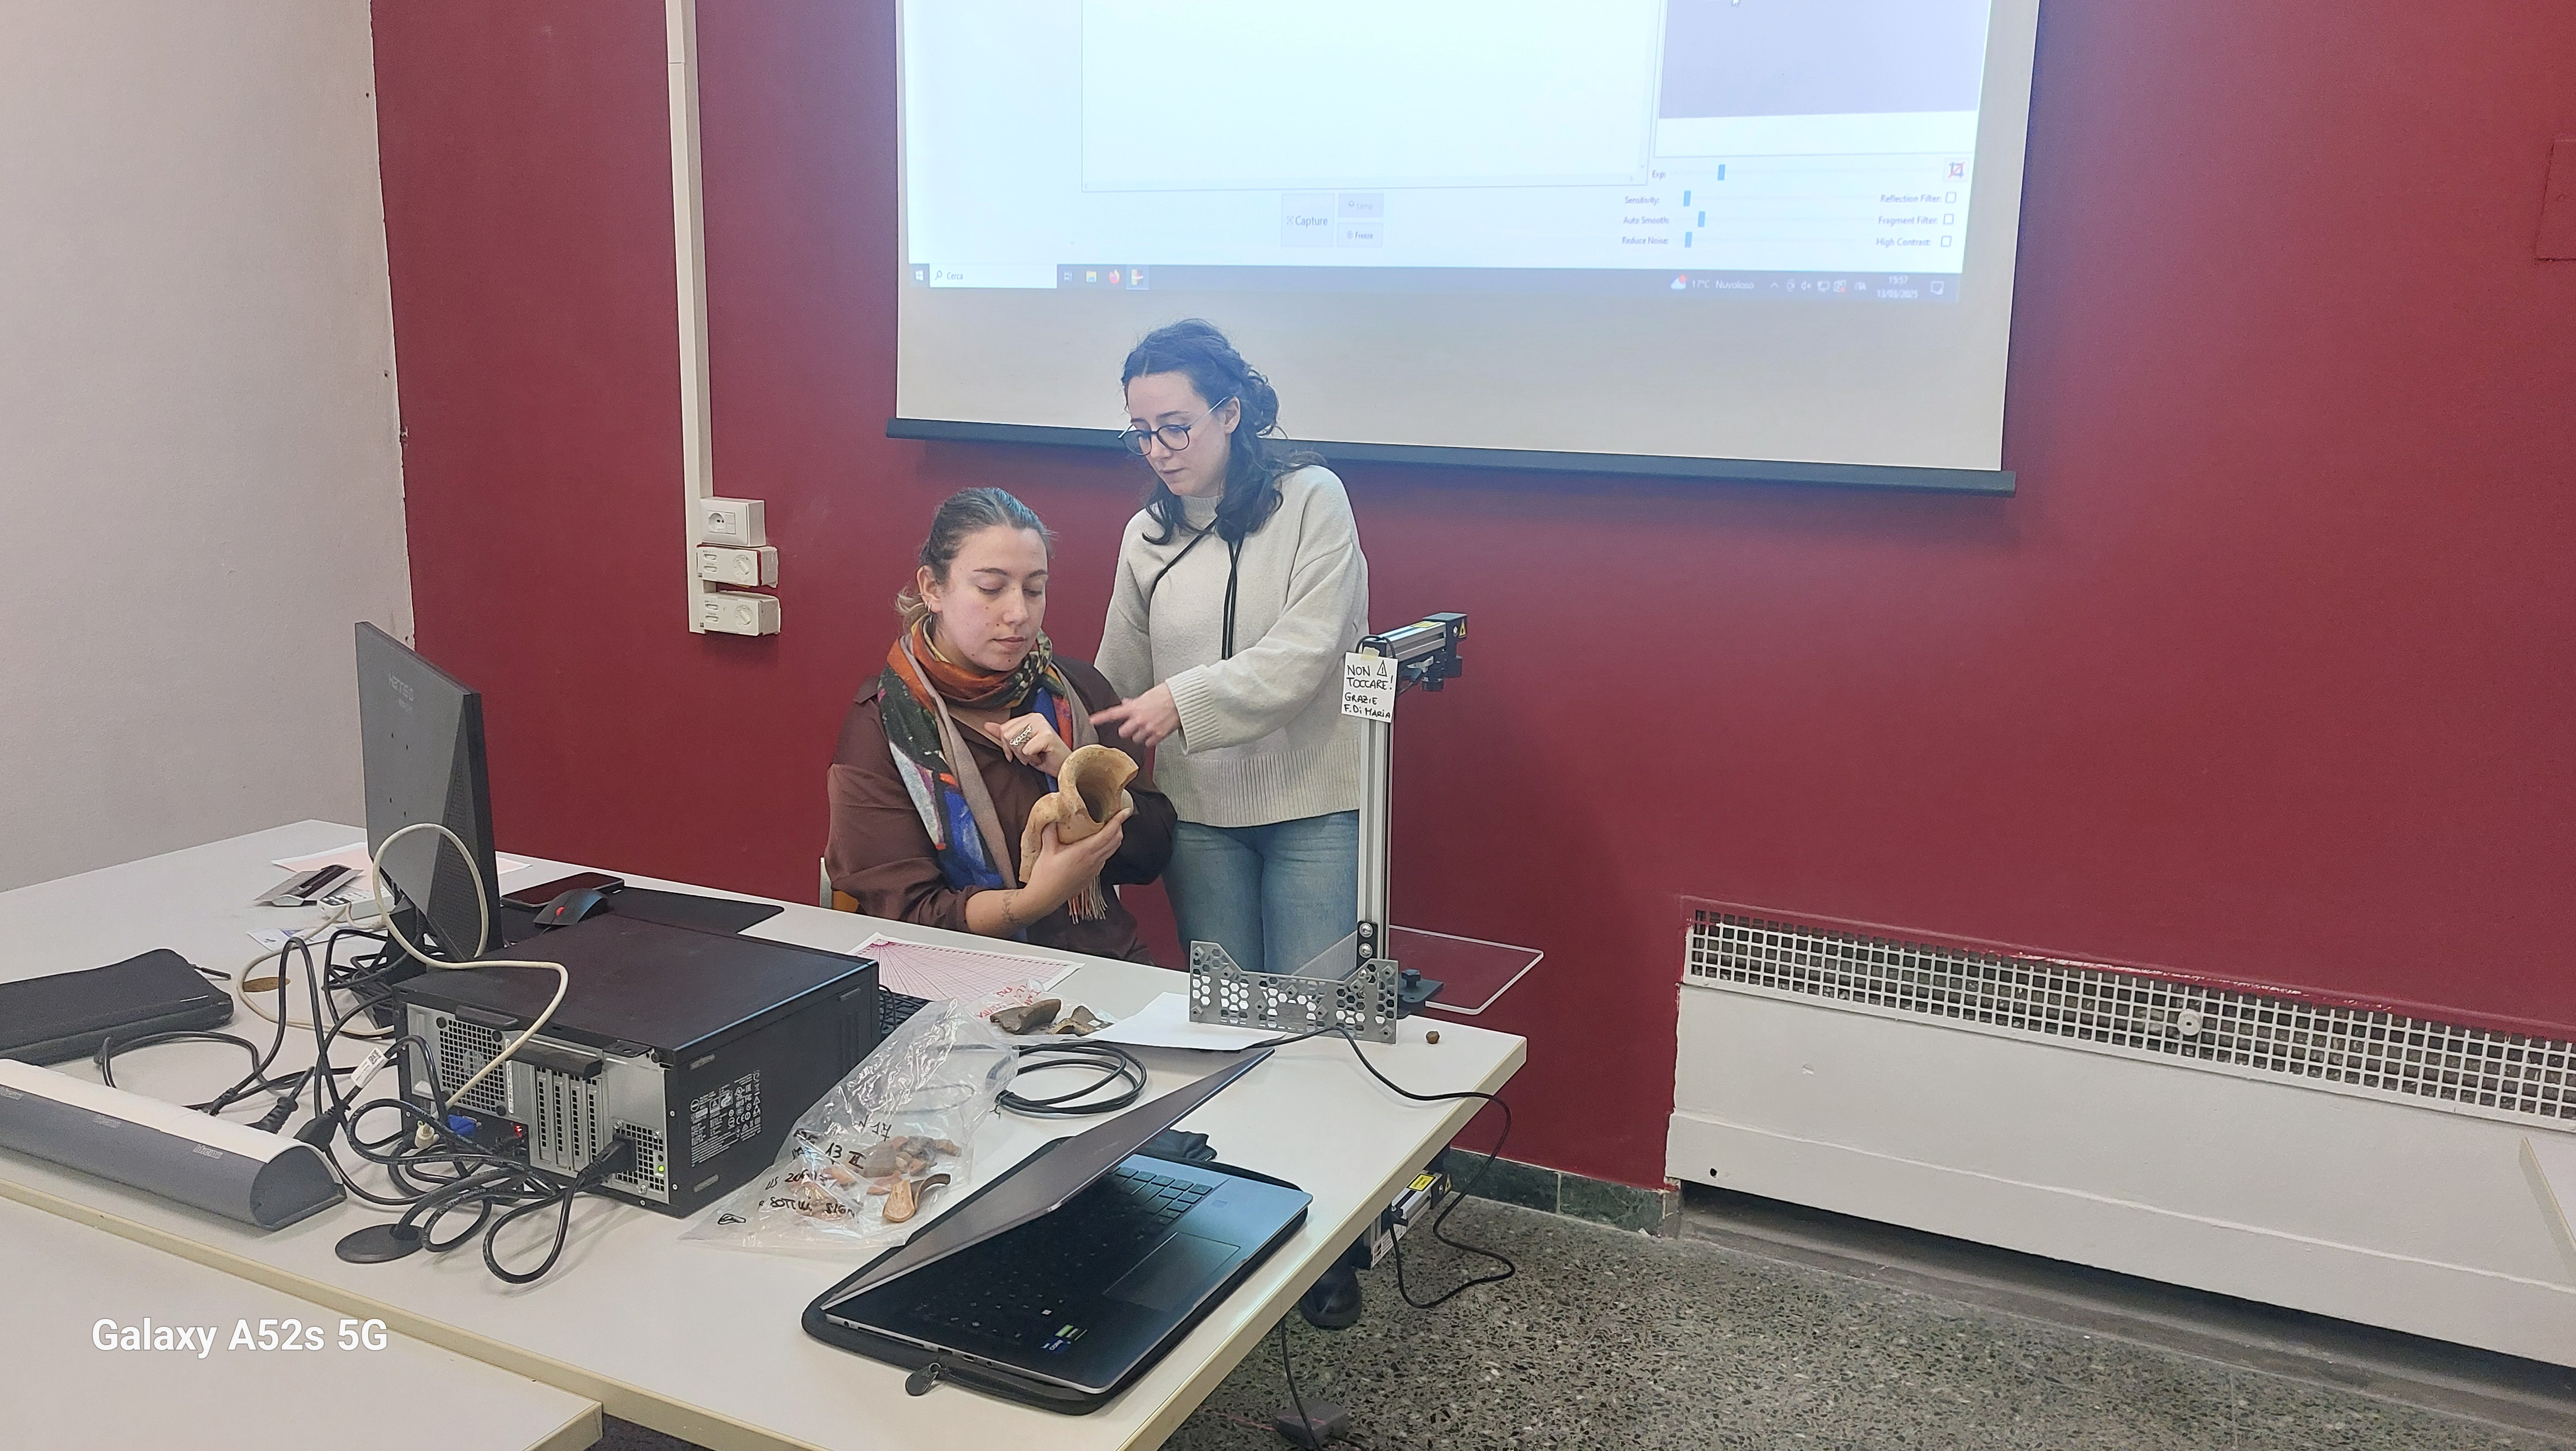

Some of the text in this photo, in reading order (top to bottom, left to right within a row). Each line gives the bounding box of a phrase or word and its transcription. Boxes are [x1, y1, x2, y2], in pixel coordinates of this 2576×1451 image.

[1880, 194, 1919, 203] Reflection
[1295, 215, 1328, 228] Capture
[1876, 237, 1895, 248] High
[1347, 664, 1370, 676] NON
[1344, 692, 1378, 705] GRAZIE
